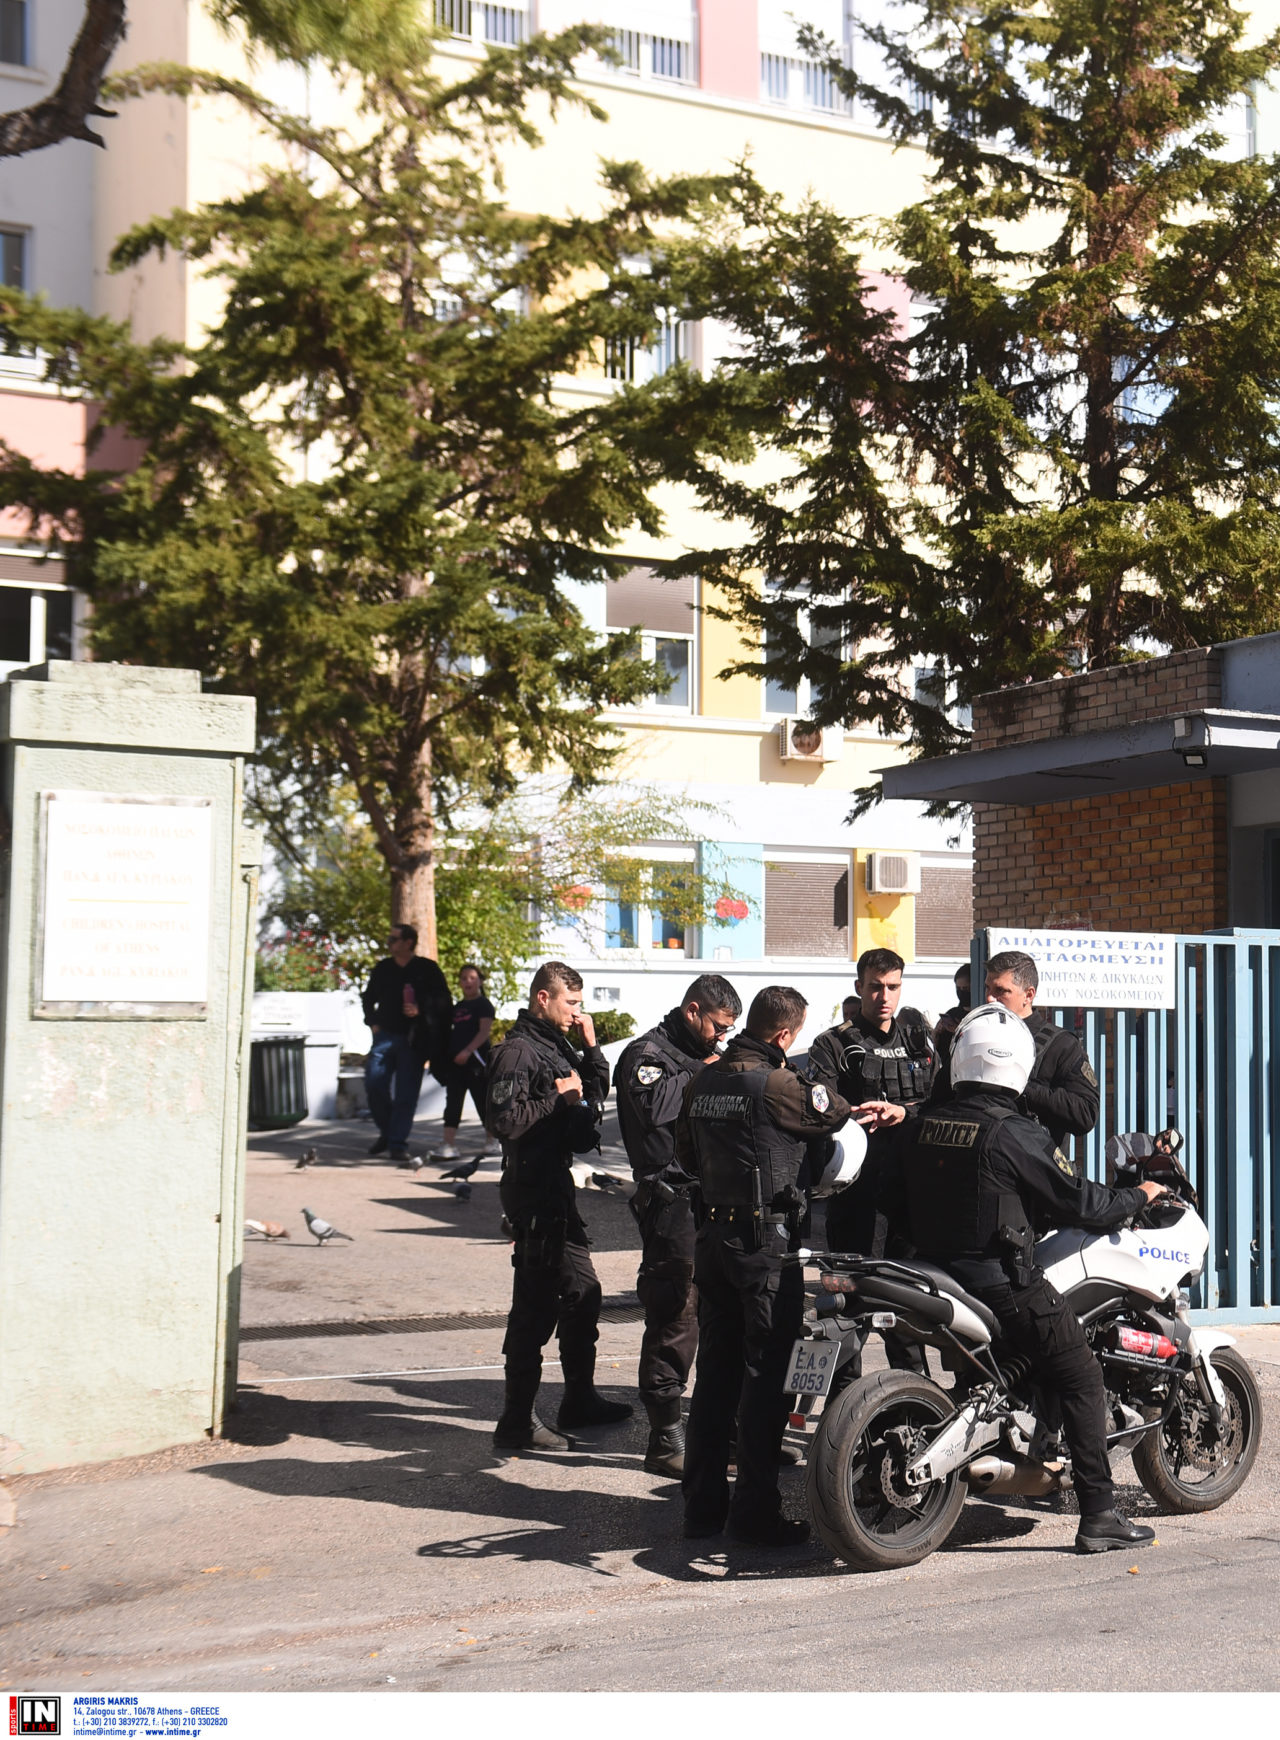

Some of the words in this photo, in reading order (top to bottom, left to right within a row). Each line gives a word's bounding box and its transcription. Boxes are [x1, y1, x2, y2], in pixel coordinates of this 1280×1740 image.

[998, 936, 1164, 951] ΑΠΑΓΟΡΕΥΕΤΑΙ
[1040, 971, 1086, 983] ΙΝΗΤΩΝ
[873, 1046, 908, 1059] POLICE
[1139, 1246, 1190, 1265] POLICE
[790, 1372, 824, 1391] 8053
